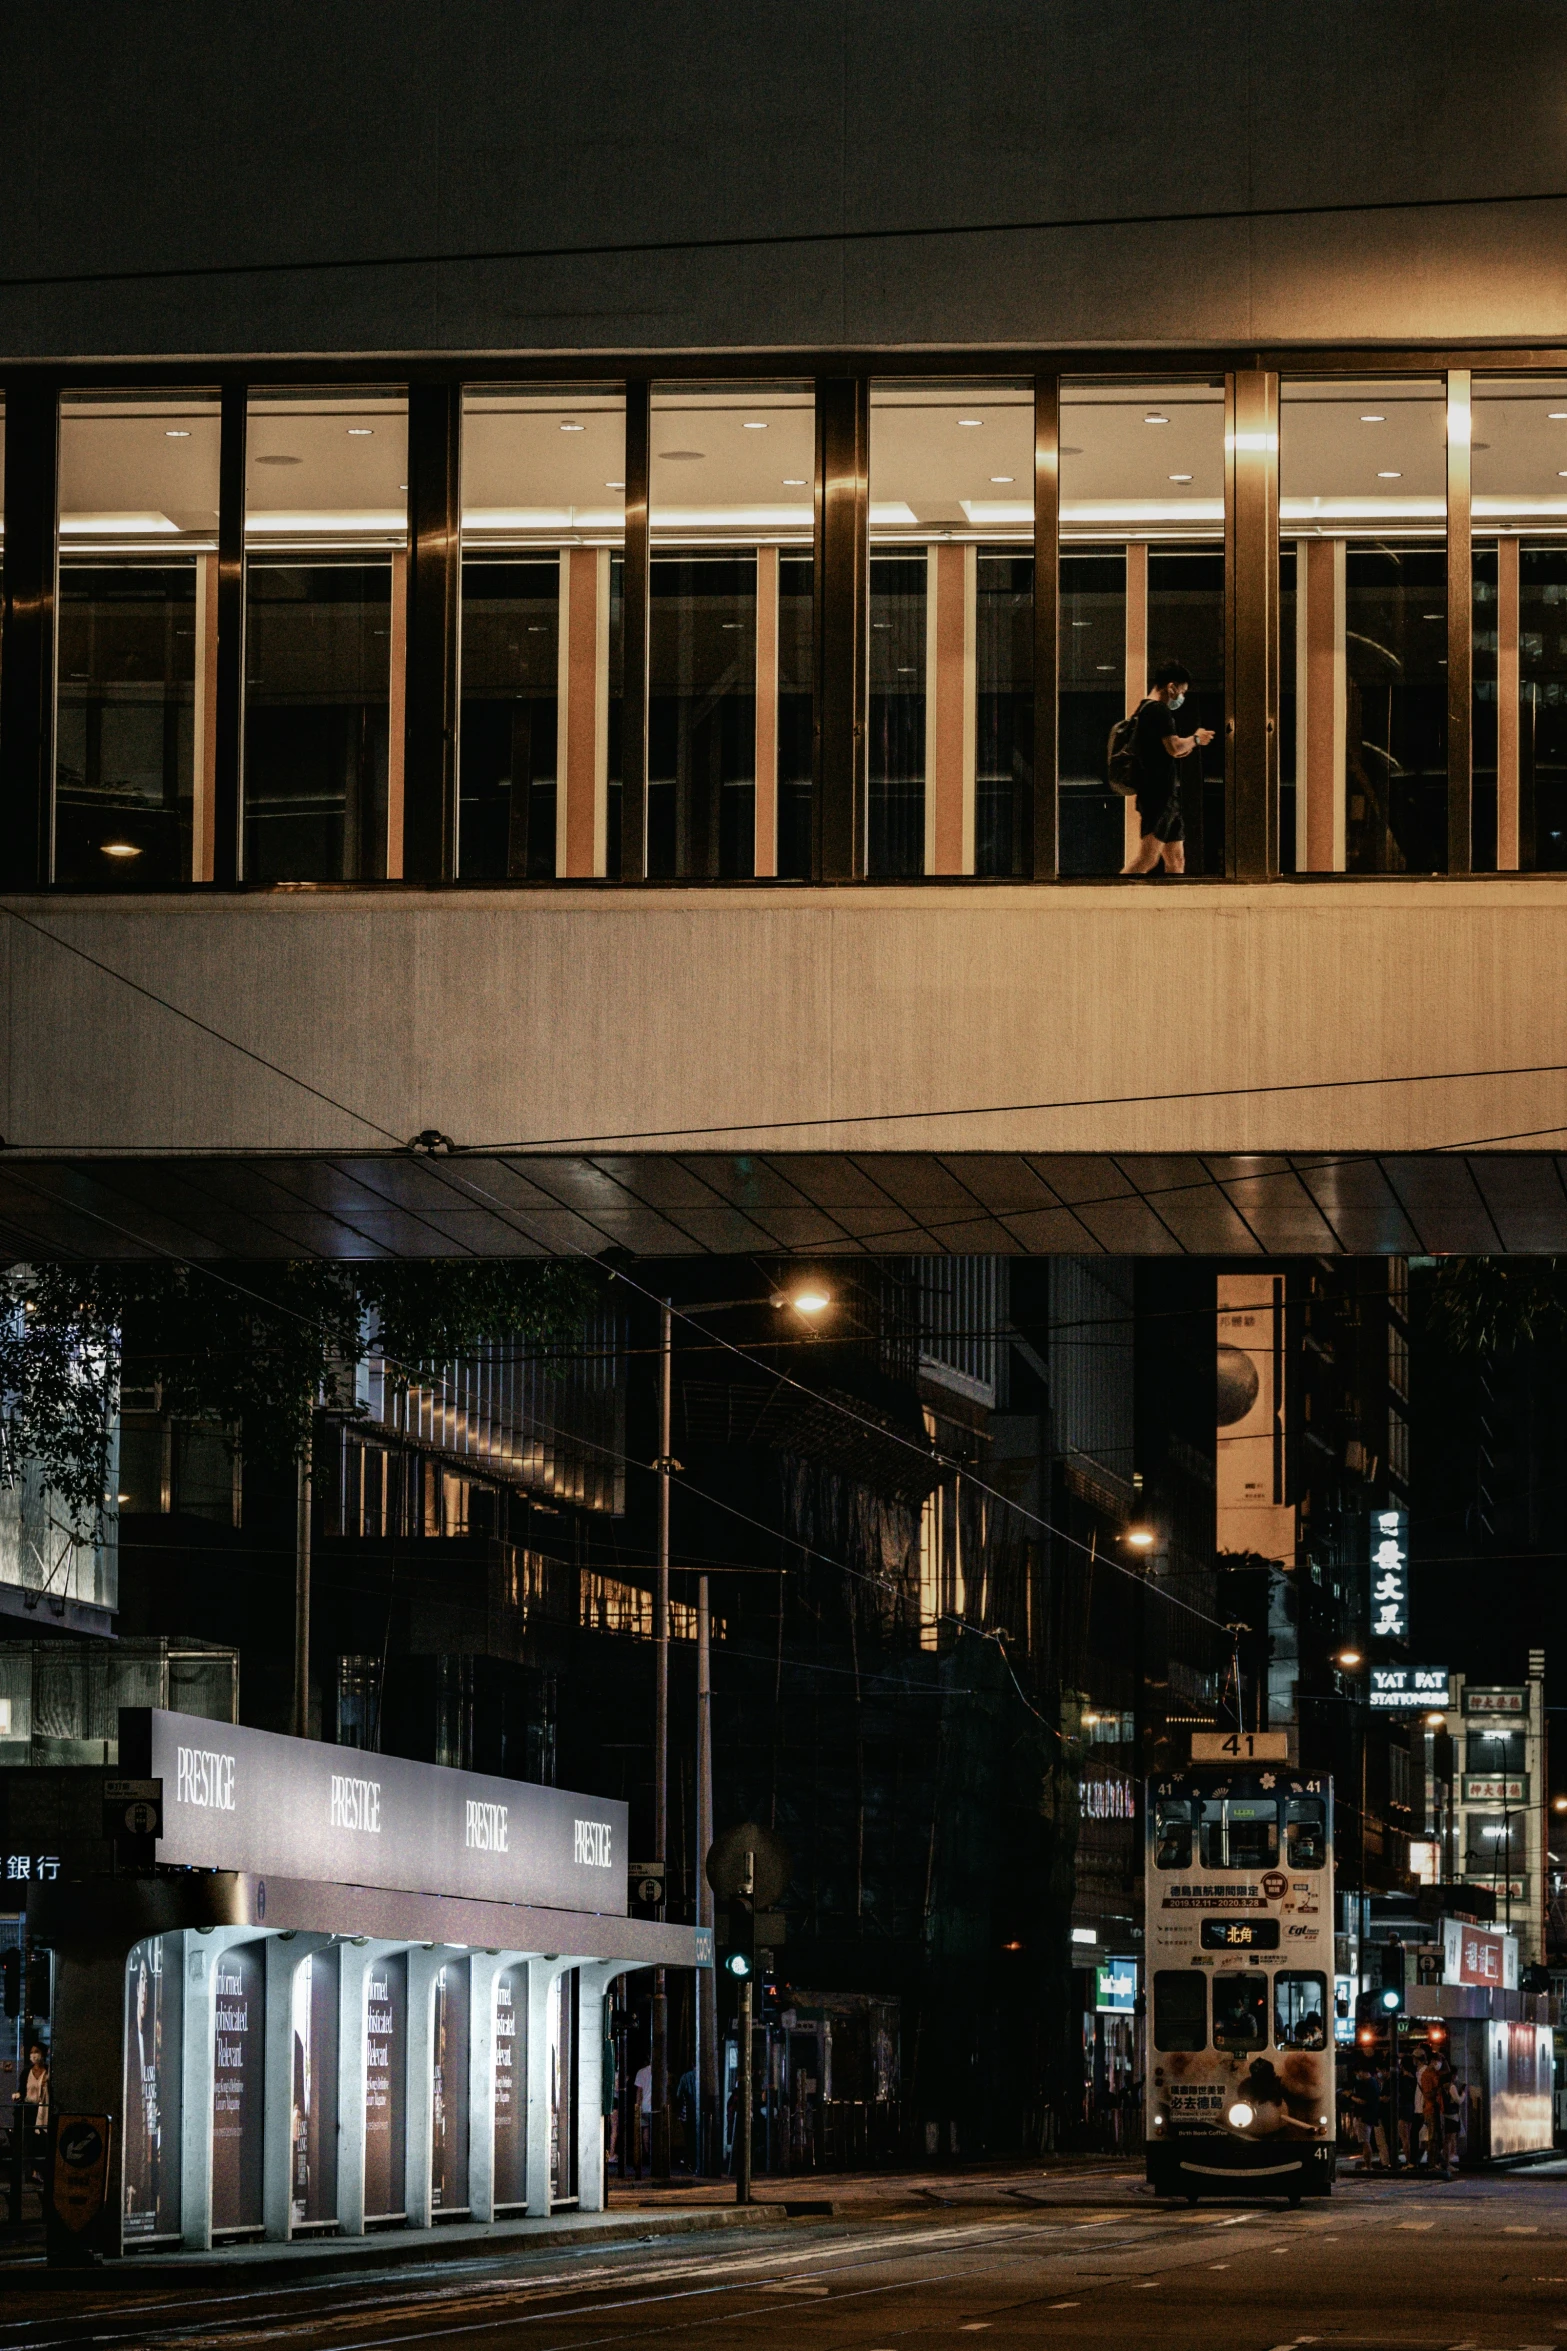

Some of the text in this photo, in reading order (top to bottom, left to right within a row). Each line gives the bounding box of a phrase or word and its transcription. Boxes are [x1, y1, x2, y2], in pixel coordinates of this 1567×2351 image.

[1373, 1672, 1446, 1688] YAT FAT
[1369, 1692, 1449, 1706] STATIONERS
[1221, 1734, 1254, 1757] 41
[177, 1746, 236, 1811] PRESTIGE
[1306, 1780, 1321, 1793] 41
[1158, 1783, 1172, 1796] 41
[330, 1774, 381, 1833] PRESTIGE
[465, 1800, 509, 1853] PRESTIGE
[574, 1819, 612, 1868] PRESTIGE
[0, 1855, 61, 1880] 銀行
[1170, 1885, 1259, 1897] 德島直航期間限定
[1227, 1926, 1253, 1943] 北角
[1171, 2096, 1224, 2110] 必去德島
[1314, 2147, 1328, 2160] 41
